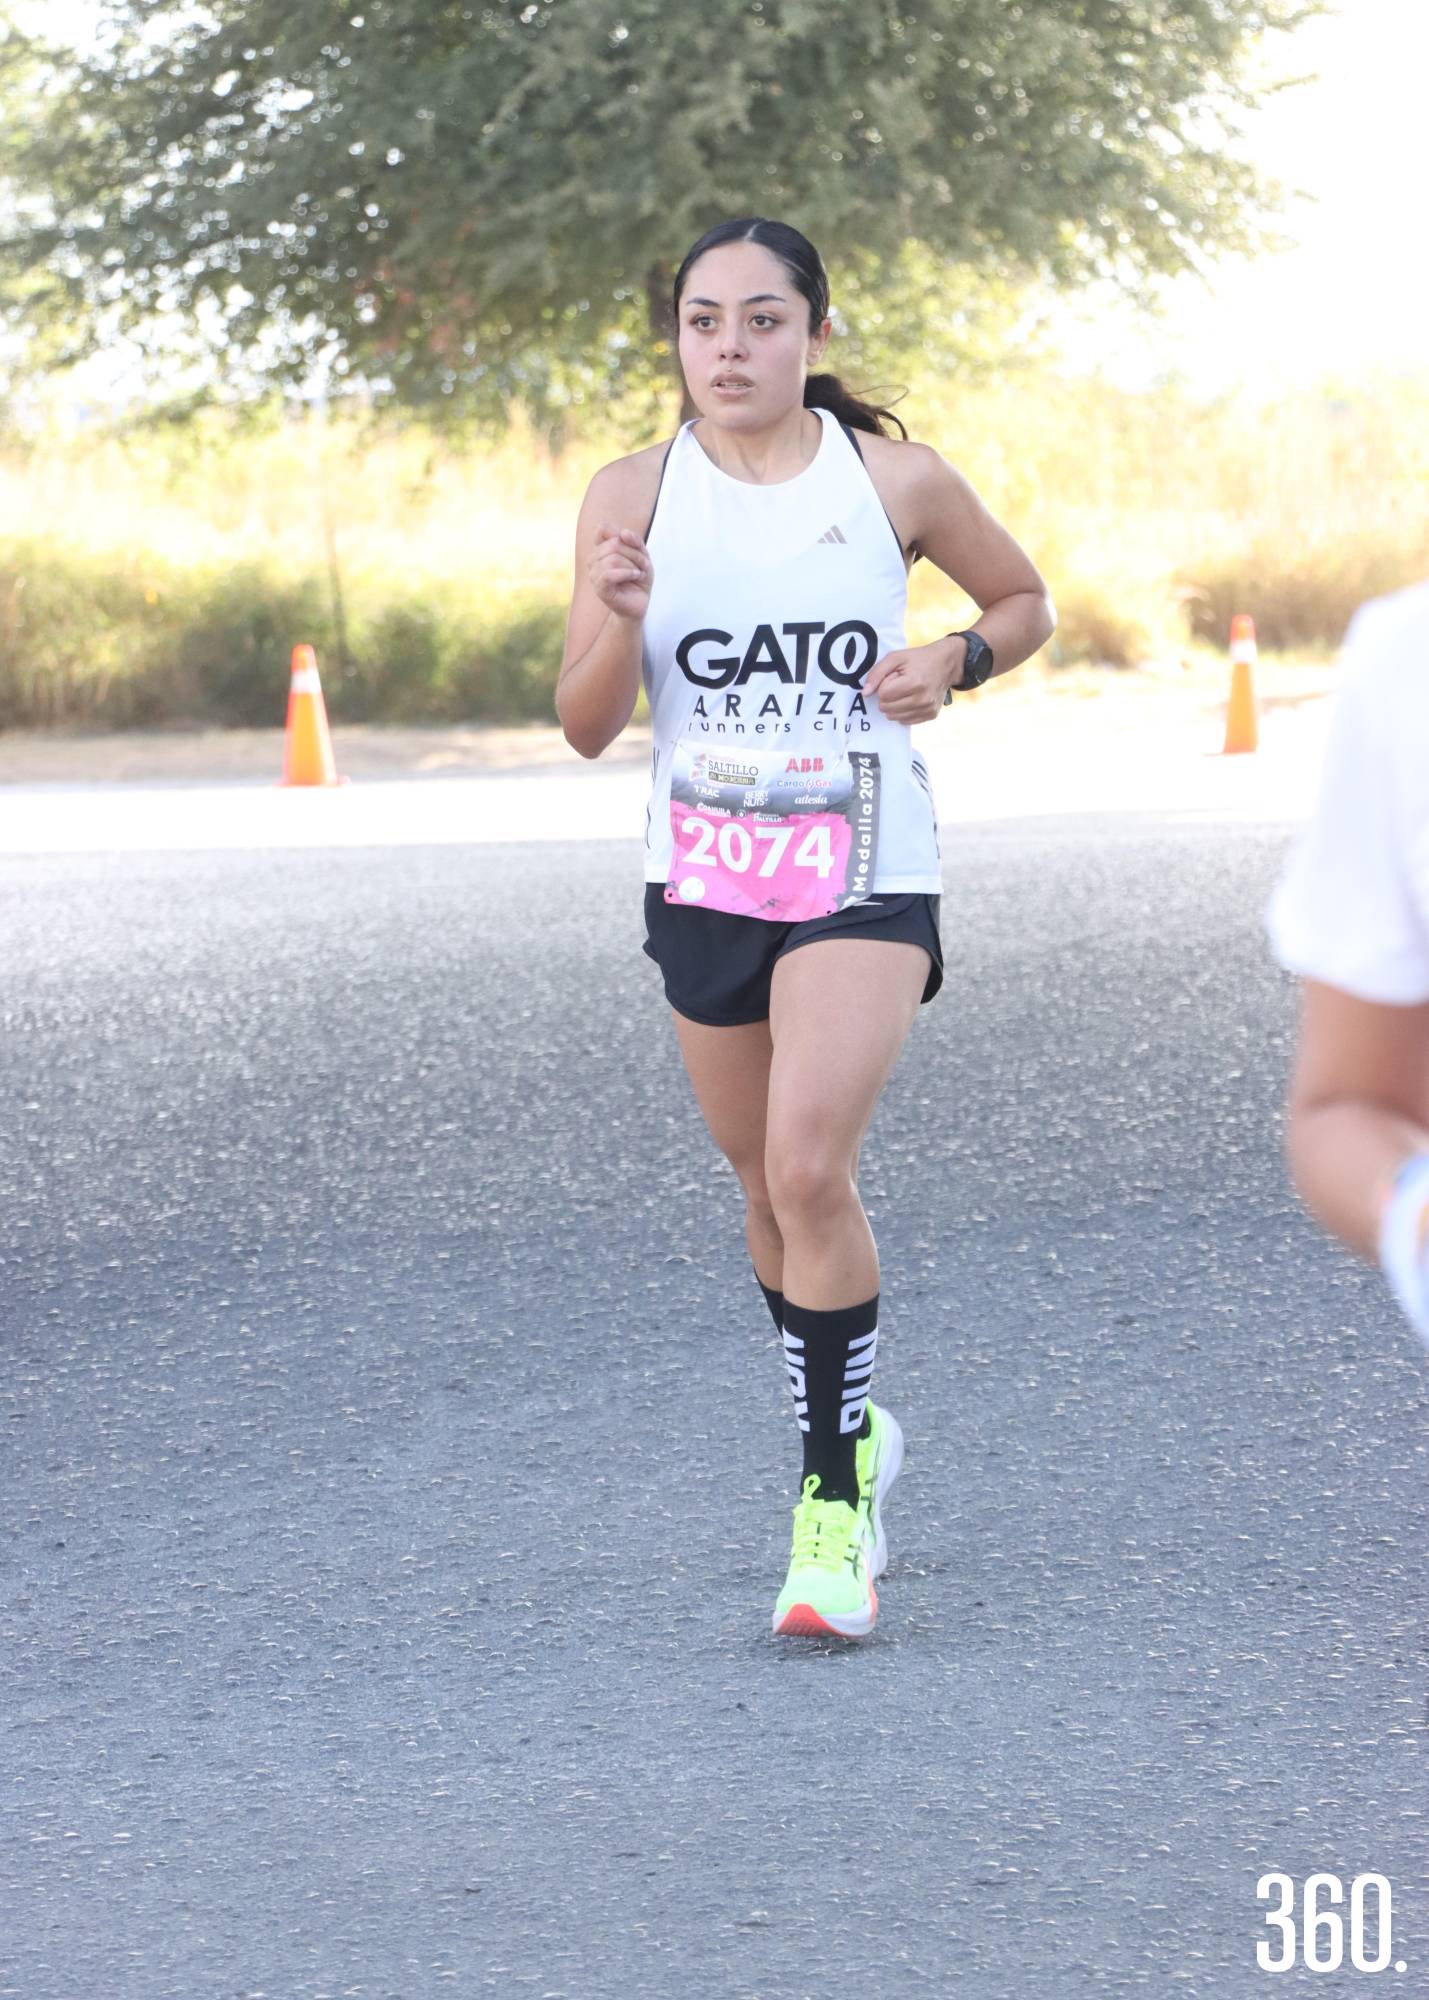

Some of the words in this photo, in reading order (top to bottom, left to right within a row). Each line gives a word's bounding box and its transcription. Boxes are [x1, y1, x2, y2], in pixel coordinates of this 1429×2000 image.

[694, 691, 868, 717] ARAIZA
[688, 721, 791, 734] runners
[813, 717, 871, 734] club
[708, 760, 759, 776] SALTILLO
[785, 757, 824, 773] ABB
[858, 757, 874, 801] 2074
[681, 816, 835, 879] 2074
[852, 804, 873, 892] Medalla
